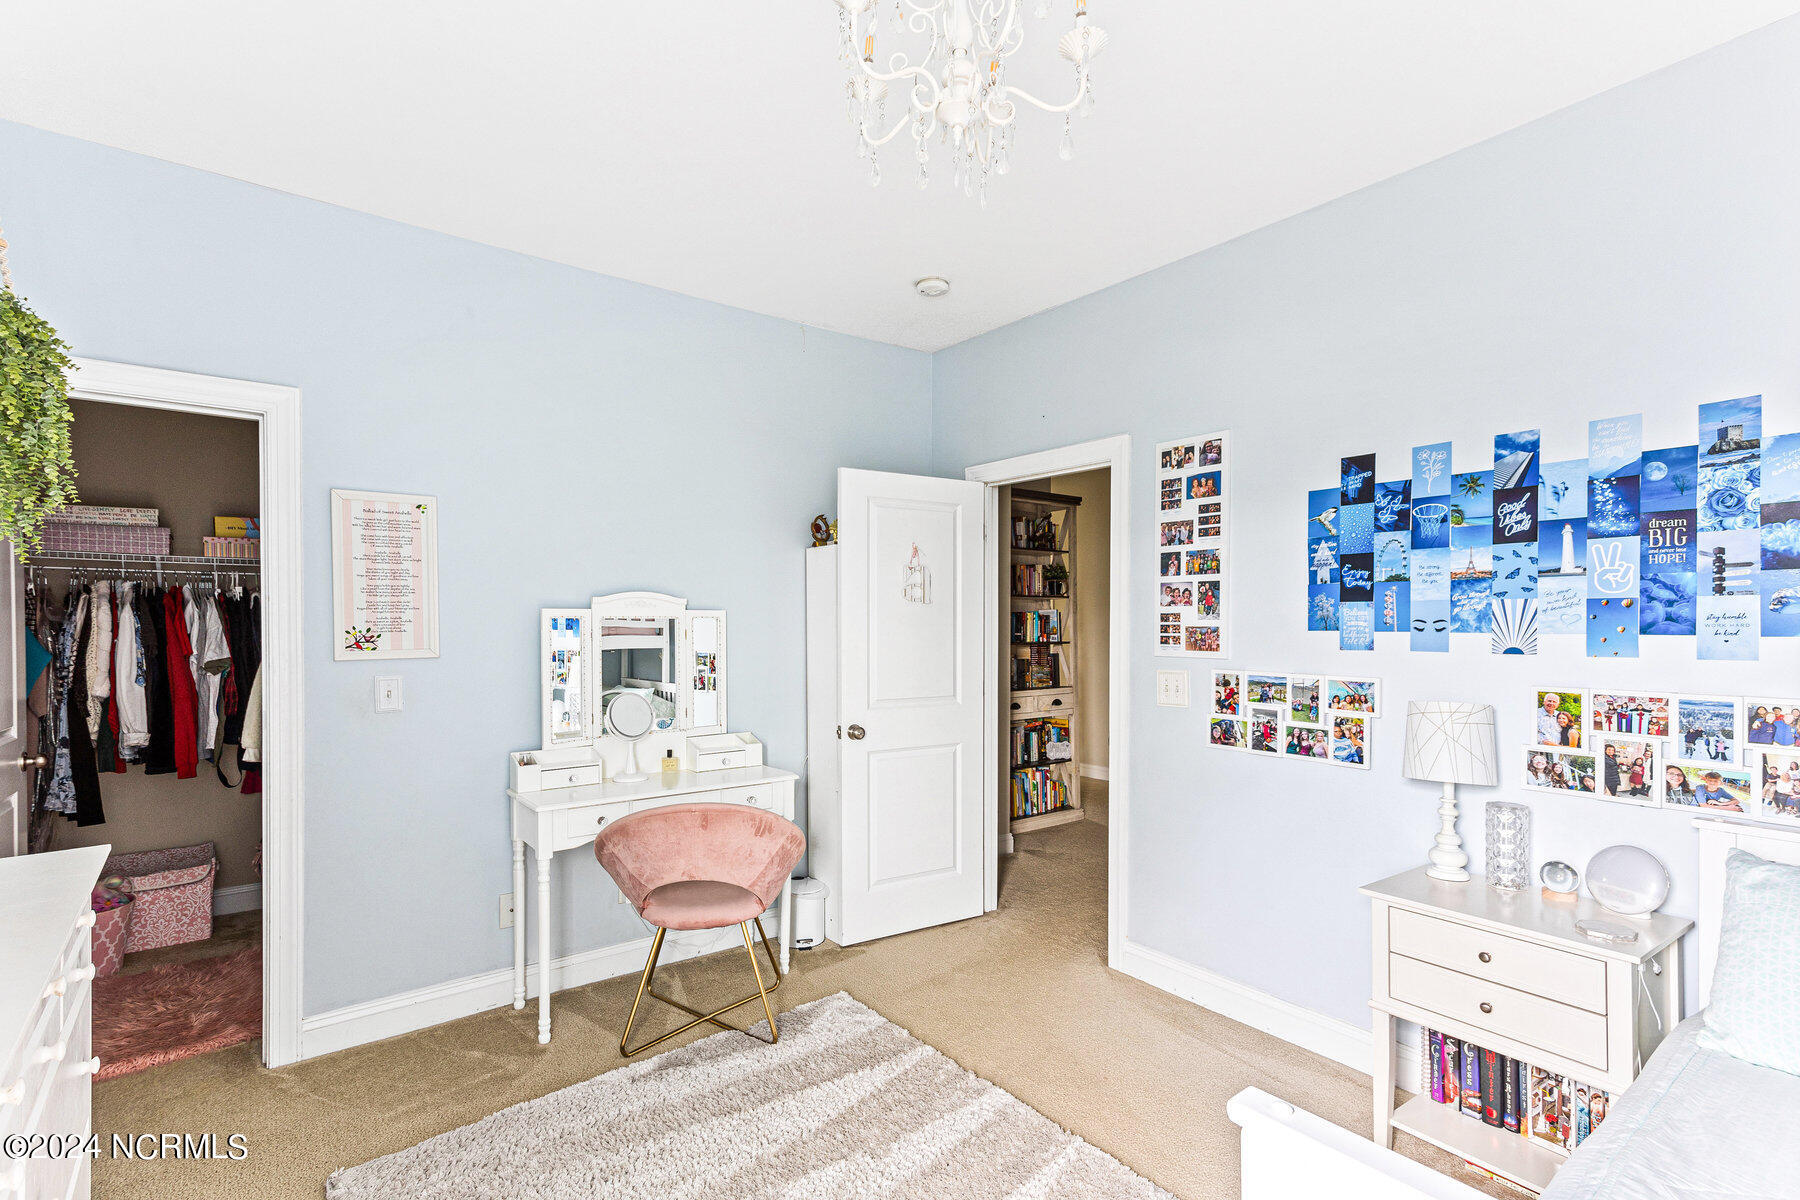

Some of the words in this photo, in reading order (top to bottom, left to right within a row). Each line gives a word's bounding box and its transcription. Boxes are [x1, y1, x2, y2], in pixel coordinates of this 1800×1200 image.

[1498, 492, 1531, 516] Good
[1499, 506, 1527, 527] Vibes
[1649, 518, 1687, 528] dream
[1505, 514, 1532, 536] Only
[1648, 527, 1688, 548] BIG
[1648, 553, 1687, 564] HOPE!
[1341, 563, 1372, 579] Enjoy
[1343, 574, 1374, 590] today
[1705, 613, 1721, 623] stay
[1722, 612, 1748, 620] humble
[1723, 629, 1740, 637] kind
[1463, 1041, 1475, 1087] Cress
